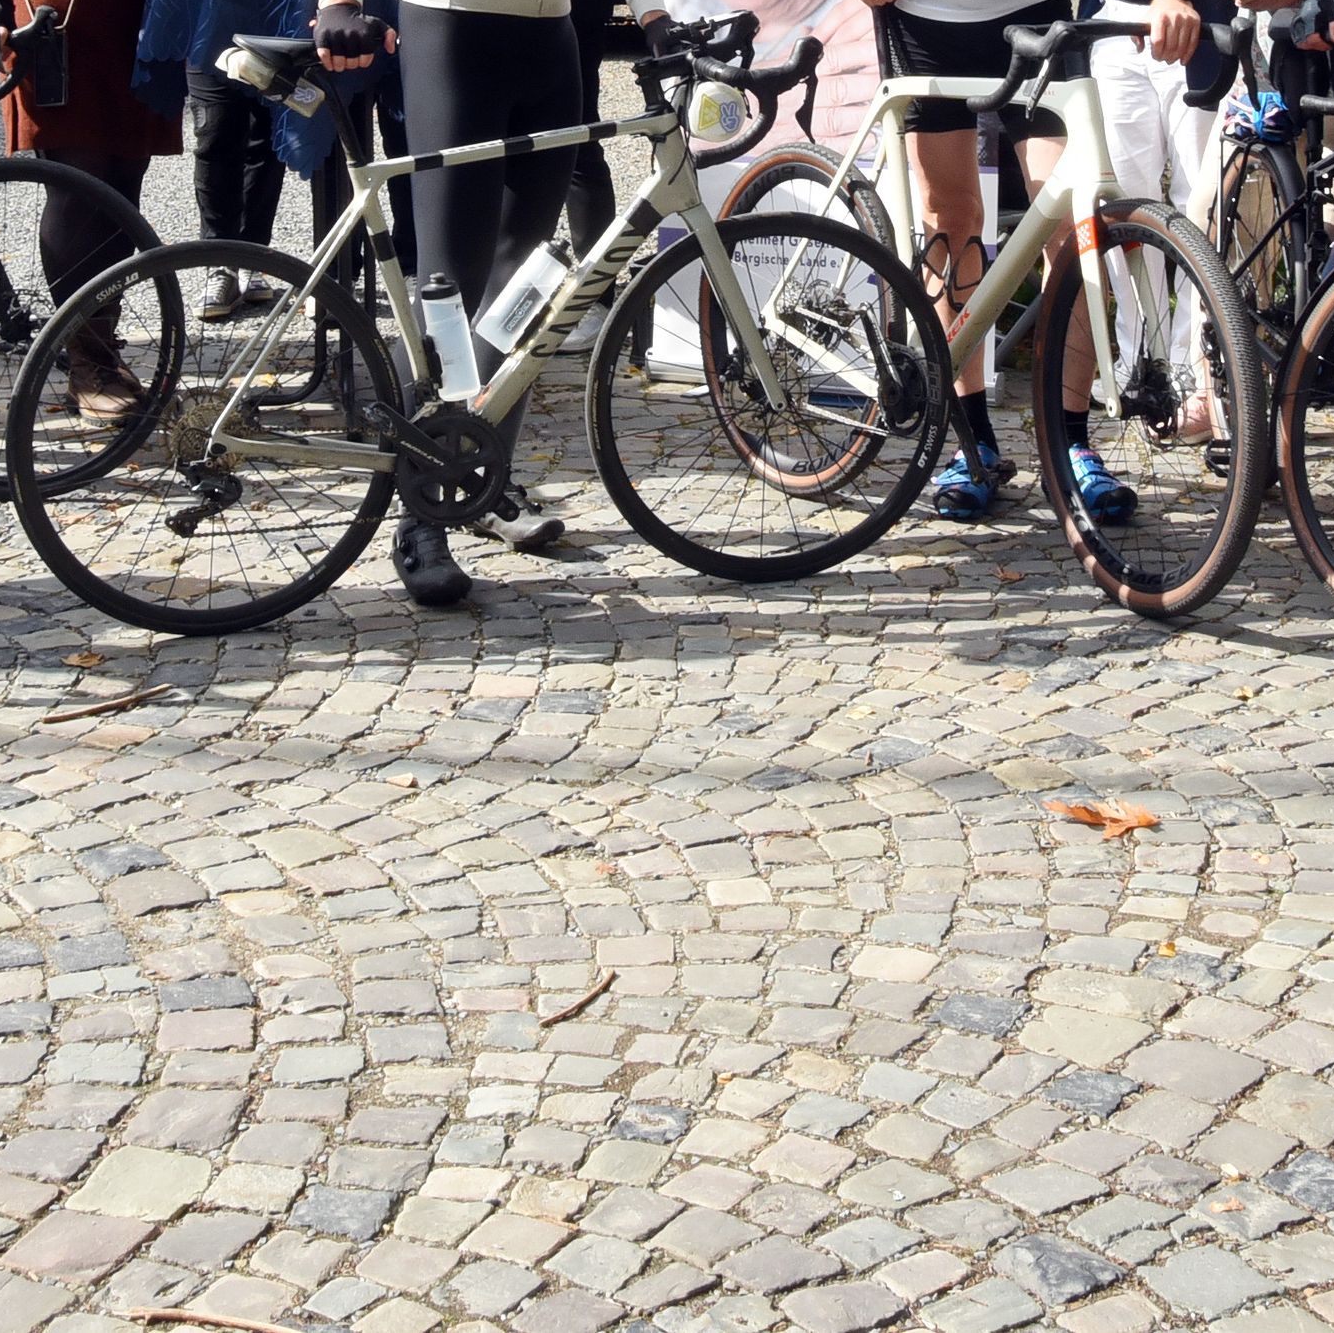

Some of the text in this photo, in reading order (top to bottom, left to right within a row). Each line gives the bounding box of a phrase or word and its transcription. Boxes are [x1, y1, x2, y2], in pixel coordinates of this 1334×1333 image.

[734, 251, 789, 267] Bergische
[95, 271, 139, 304] DT SWISS
[917, 424, 939, 469] DT SWISS
